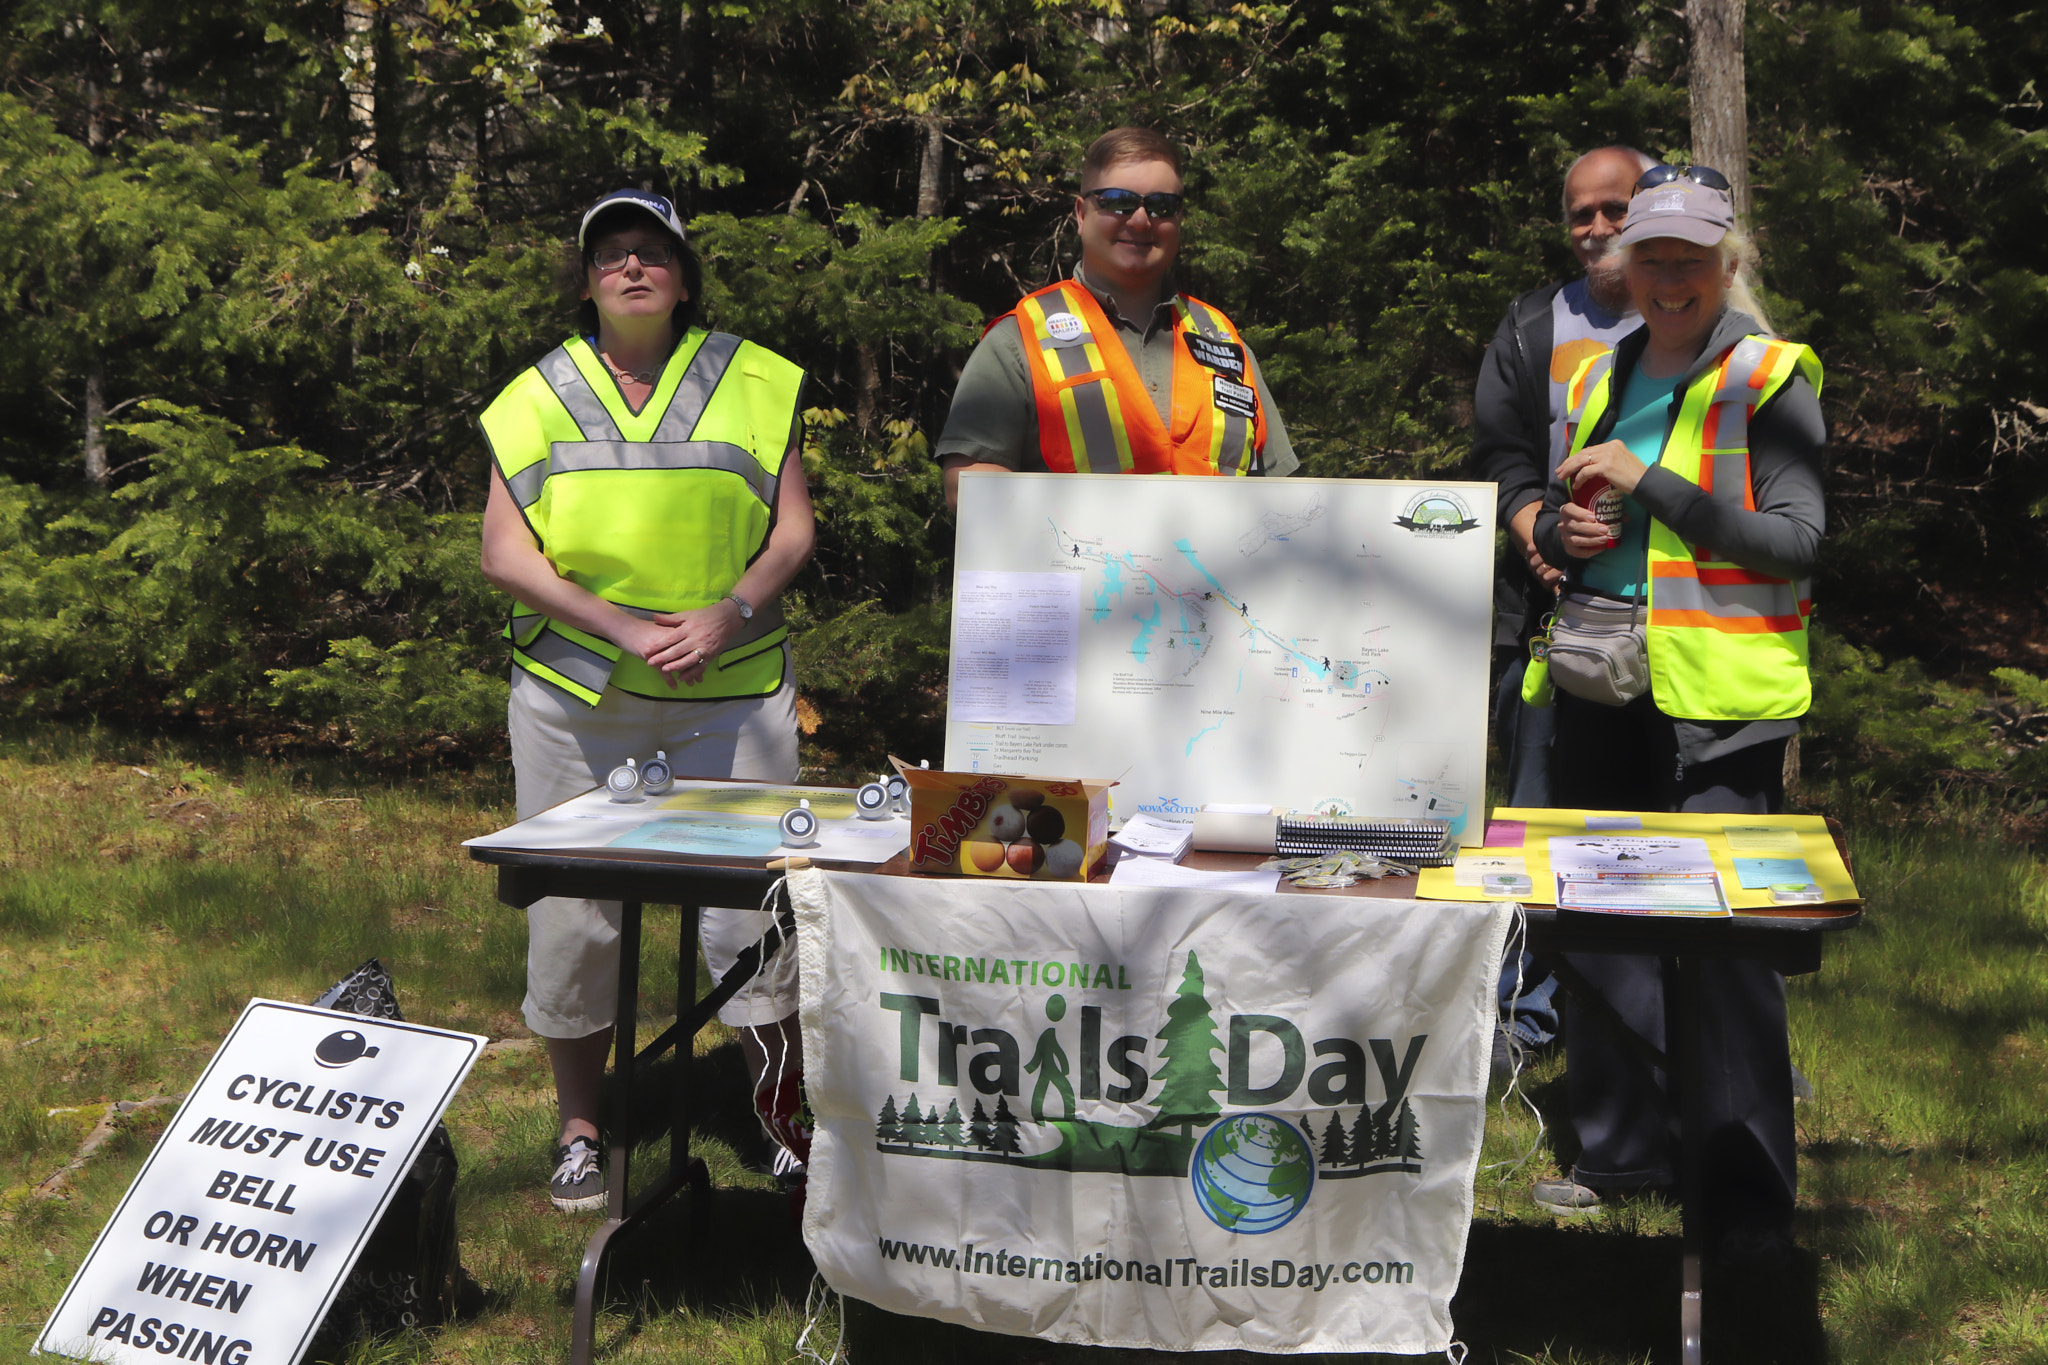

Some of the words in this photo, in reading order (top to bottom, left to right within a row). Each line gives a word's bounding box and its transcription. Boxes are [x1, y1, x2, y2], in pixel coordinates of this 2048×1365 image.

[1052, 327, 1080, 335] HALIFAX
[1195, 339, 1236, 358] TRAIL
[1193, 348, 1243, 374] WARDEN
[1219, 380, 1232, 388] Nova
[1232, 385, 1249, 394] Scotia
[1221, 387, 1232, 395] Trail
[1233, 391, 1249, 400] Patrol
[1137, 804, 1163, 813] NOVA
[880, 946, 1132, 991] INTERNATIONAL
[880, 991, 1148, 1112] Trails
[1226, 1013, 1429, 1125] Day
[227, 1073, 405, 1130] CYCLISTS
[189, 1117, 304, 1160] MUST
[304, 1136, 386, 1179] USE
[205, 1169, 297, 1215] BELL
[143, 1209, 200, 1247] OR
[200, 1221, 317, 1273] HORN
[136, 1260, 253, 1314] WHEN
[878, 1235, 1415, 1294] www.InternationalTrailsDay.com
[87, 1306, 253, 1365] PASSING
